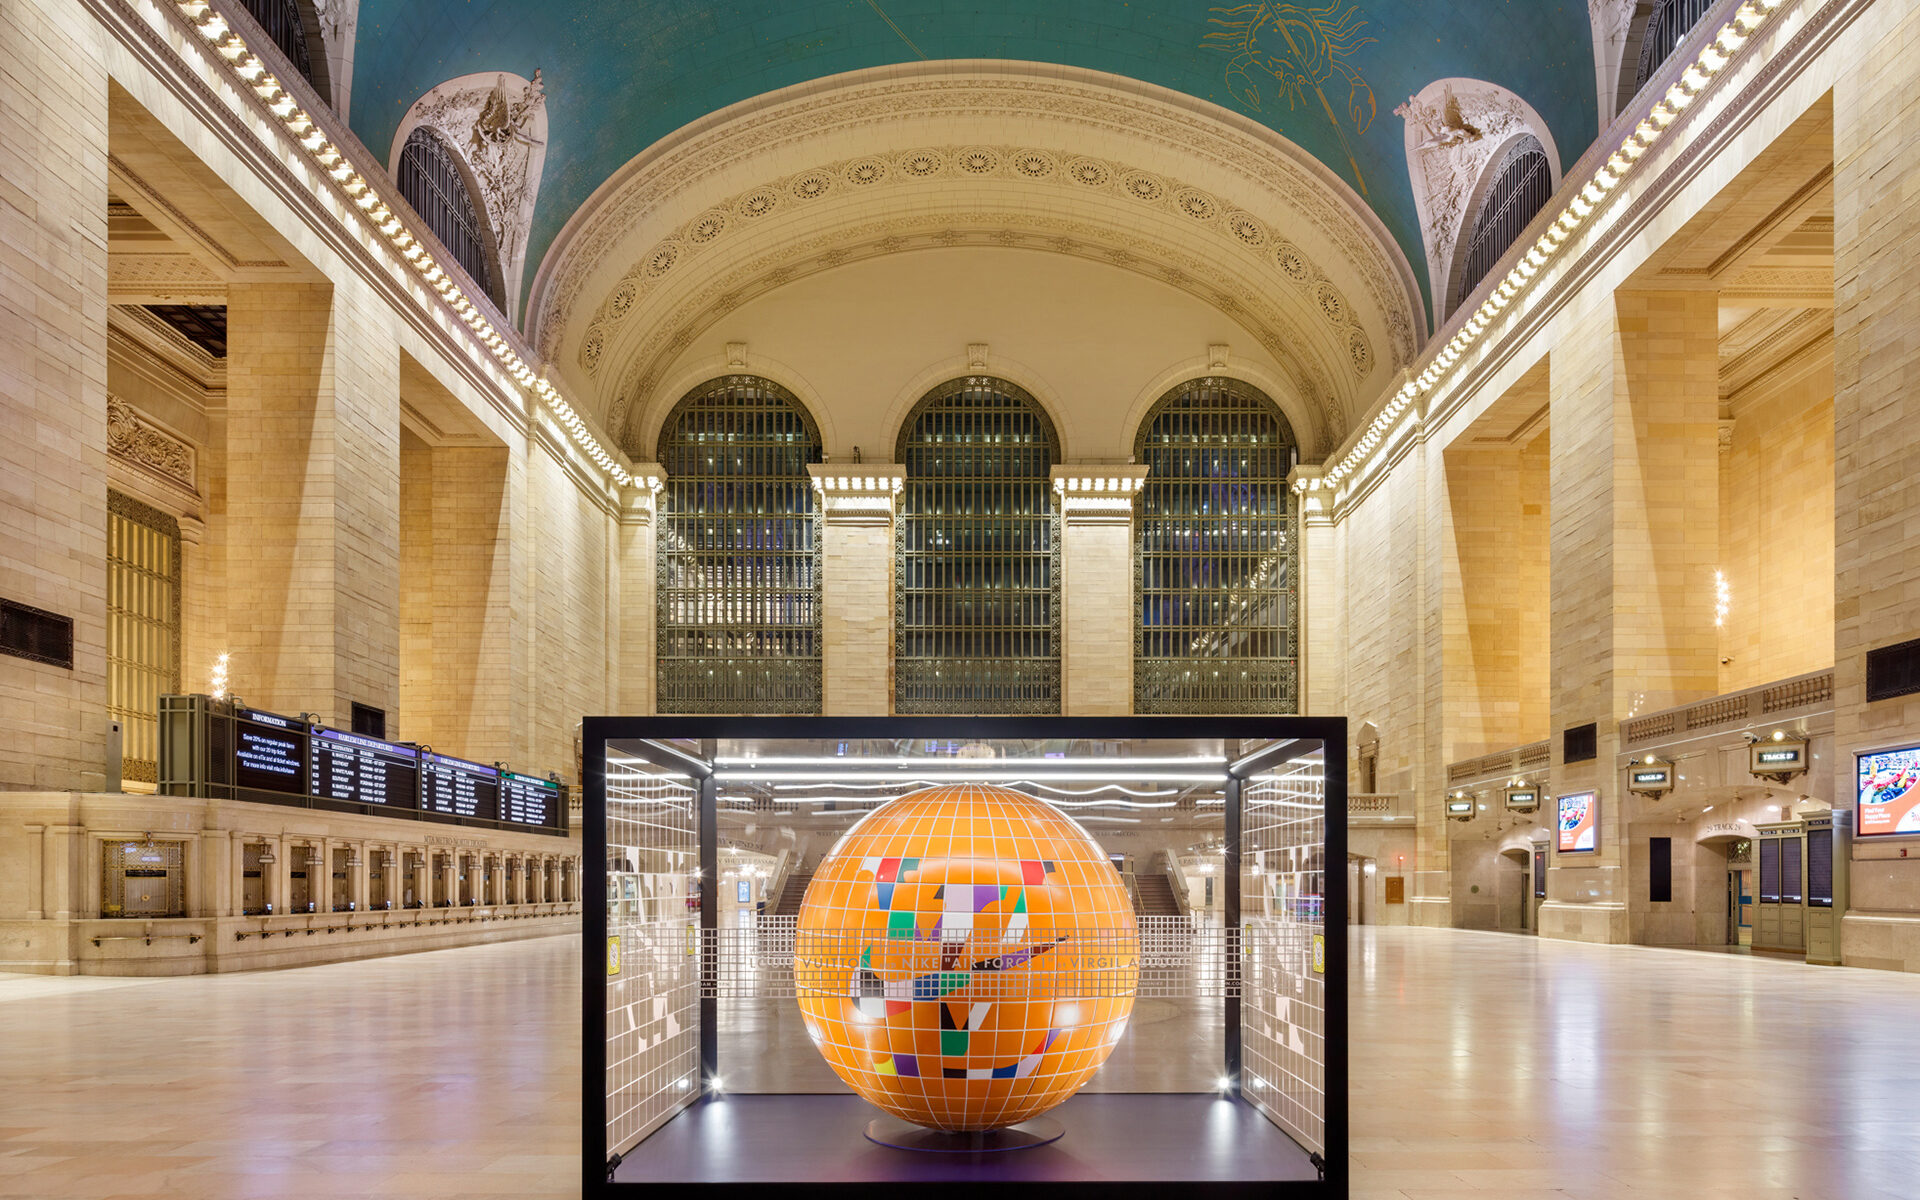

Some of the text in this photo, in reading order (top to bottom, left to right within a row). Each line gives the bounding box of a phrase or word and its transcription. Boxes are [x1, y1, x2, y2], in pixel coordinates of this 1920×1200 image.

[252, 713, 286, 727] INFORMATION
[750, 958, 794, 968] LOUIS
[803, 958, 871, 968] VUITTON
[902, 958, 938, 968] NIKE
[944, 958, 977, 968] "AIR
[984, 958, 1032, 968] FORCE
[1070, 958, 1122, 968] VIRGIL
